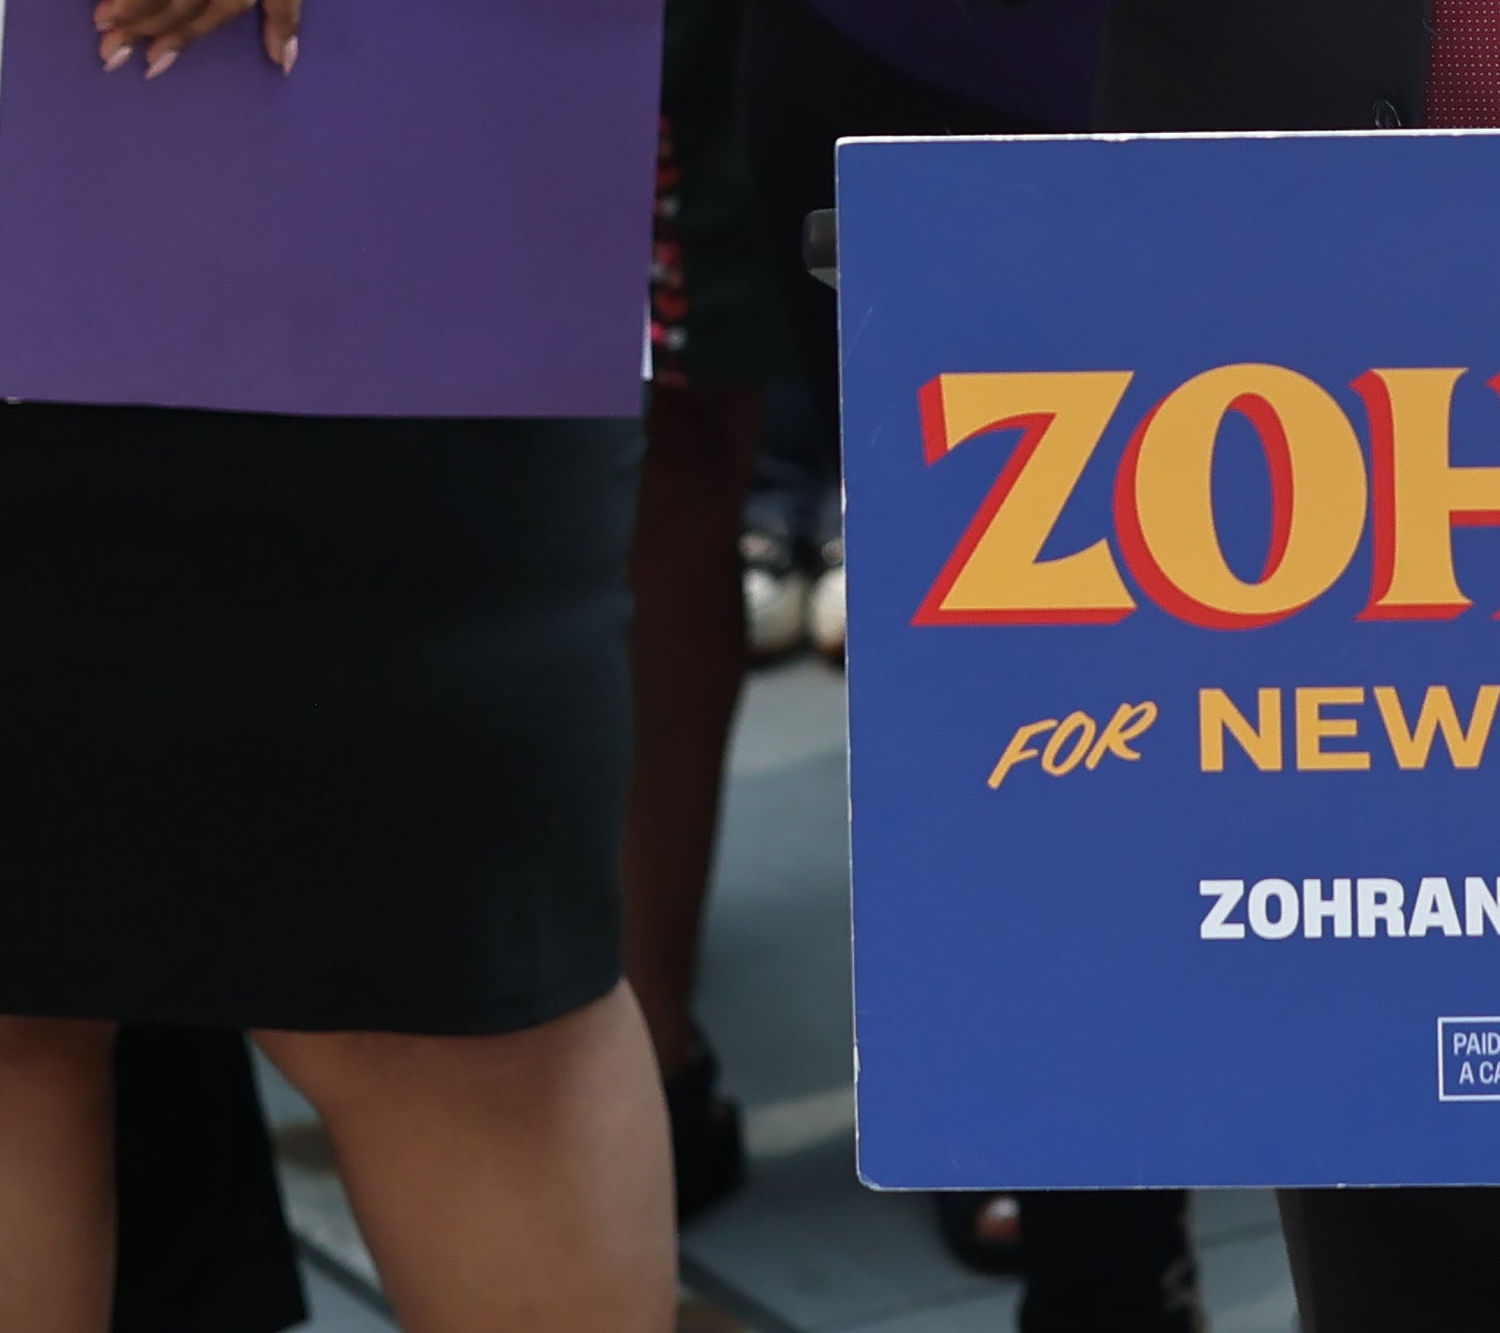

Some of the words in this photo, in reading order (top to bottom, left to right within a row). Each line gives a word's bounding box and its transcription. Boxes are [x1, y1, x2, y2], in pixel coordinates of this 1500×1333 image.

[987, 700, 1158, 790] FOR
[1453, 1031, 1500, 1055] PAID
[1459, 1060, 1476, 1084] A
